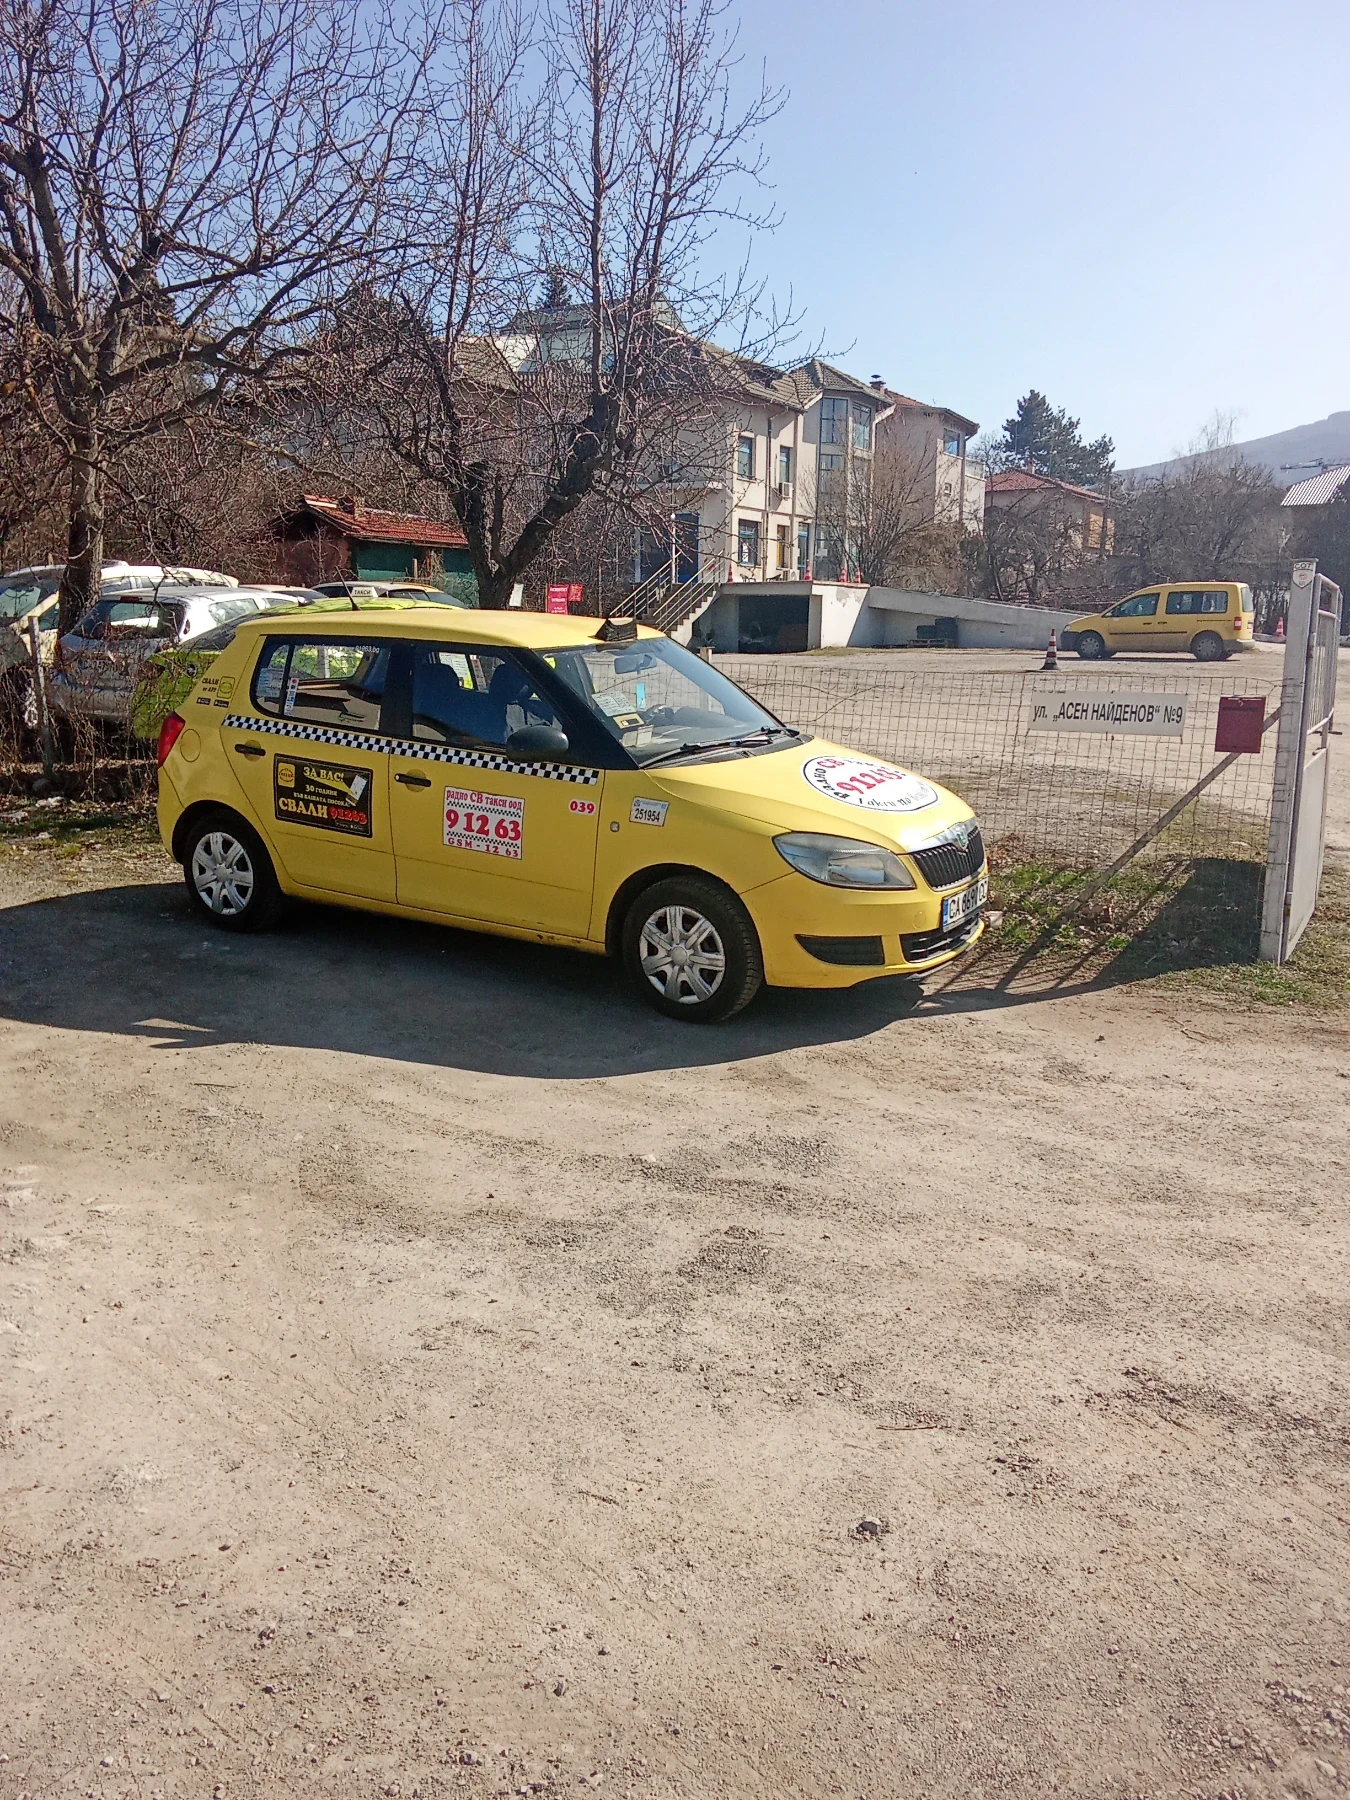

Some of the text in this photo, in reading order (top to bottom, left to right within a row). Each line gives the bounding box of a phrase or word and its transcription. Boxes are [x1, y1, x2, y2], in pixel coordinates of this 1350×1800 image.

[1033, 701, 1183, 725] ул. „АСЕН НАЙДЕНОВ“ №9
[303, 766, 318, 778] ЗА
[320, 769, 345, 782] ВАС!
[305, 784, 315, 792] 30
[446, 789, 468, 801] радио
[469, 792, 484, 804] СВ
[485, 797, 508, 808] такси
[279, 797, 328, 819] СВАЛИ
[329, 806, 368, 825] 91263
[570, 800, 595, 814] 039
[634, 808, 661, 822] 251954
